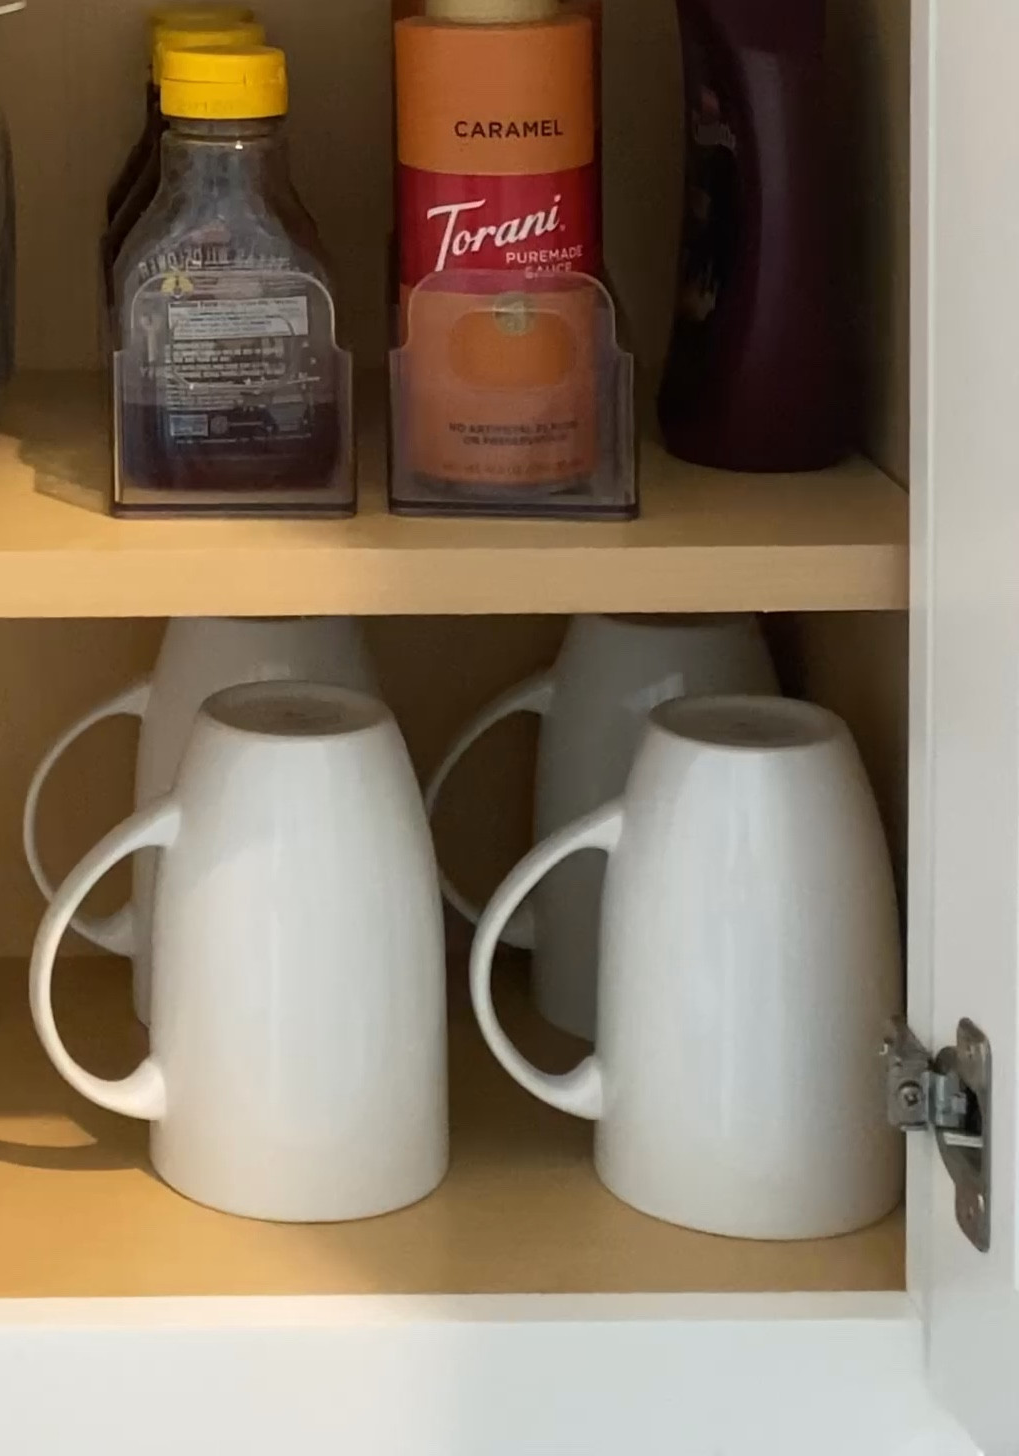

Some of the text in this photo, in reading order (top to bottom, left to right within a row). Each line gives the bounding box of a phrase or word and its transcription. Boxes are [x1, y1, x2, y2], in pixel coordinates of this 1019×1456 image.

[454, 119, 564, 138] CARAMEL
[427, 194, 562, 272] Torani
[505, 245, 583, 264] PUREMADE
